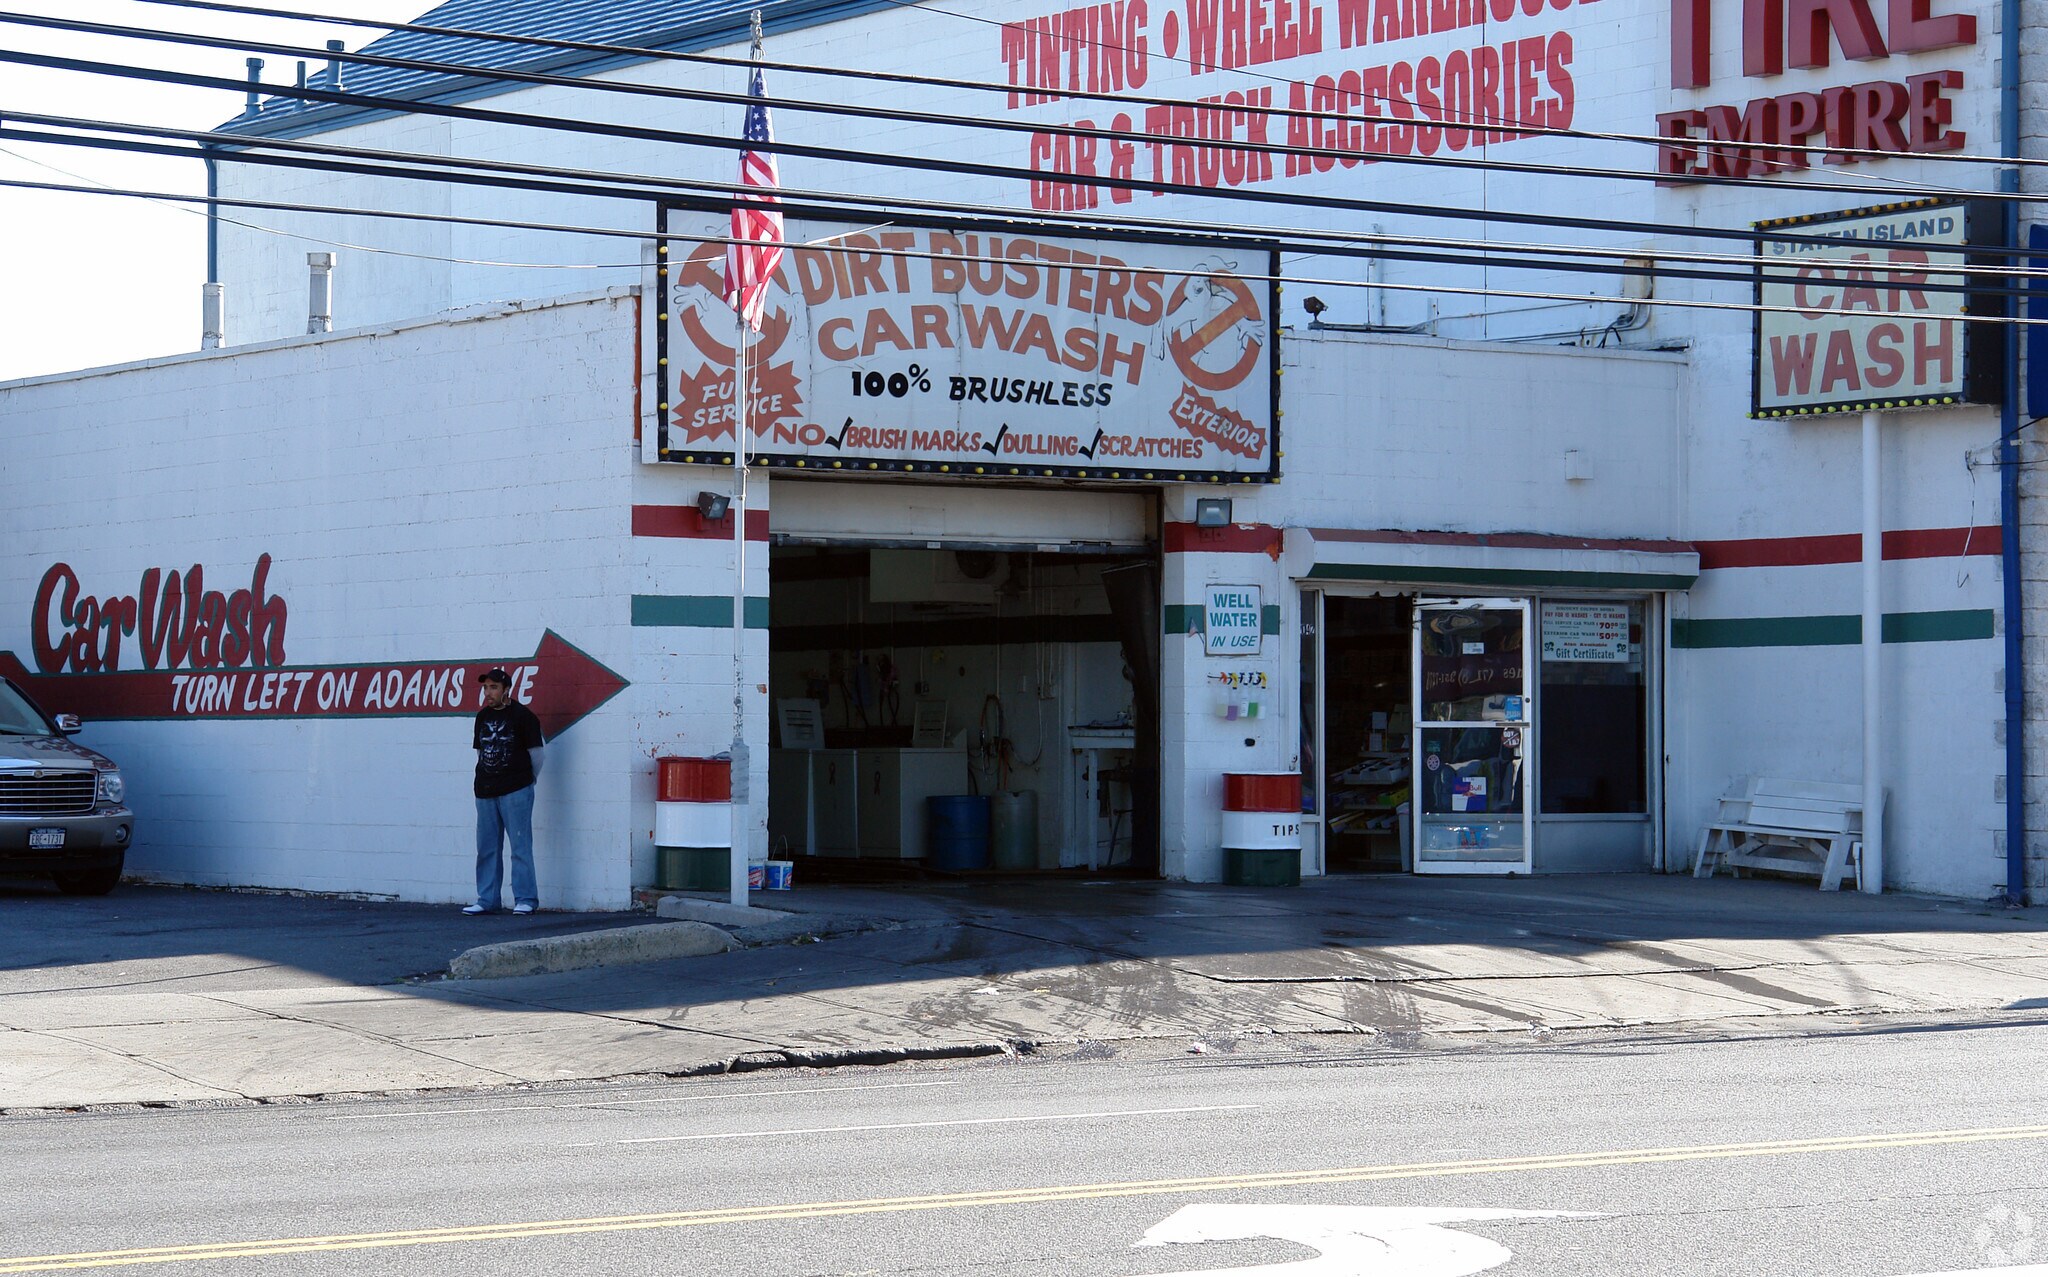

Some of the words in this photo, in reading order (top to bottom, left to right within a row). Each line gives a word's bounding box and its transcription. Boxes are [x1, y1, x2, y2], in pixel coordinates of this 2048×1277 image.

[1001, 0, 1148, 110] TINTING
[1186, 0, 1323, 76] WHEEL
[1030, 119, 1099, 212] CAR
[1110, 112, 1135, 205] &
[1145, 86, 1273, 197] TRUCK
[1286, 30, 1574, 179] ACCESSORIES
[1655, 70, 1967, 188] EMPIRE
[1867, 216, 1955, 241] ISLAND
[793, 232, 916, 306] DIRT
[929, 231, 1165, 327] BUSTERS
[1794, 248, 1930, 321] CAR
[817, 304, 955, 362] CAR
[961, 303, 1146, 386] WASH
[1769, 320, 1954, 397] WASH
[702, 377, 763, 404] FUL
[851, 363, 932, 398] 100%
[949, 376, 1113, 408] BRUSHLESS
[773, 422, 826, 446] NO
[846, 425, 907, 450] BRUSH
[911, 428, 982, 453] MARKS
[1003, 432, 1079, 456] DULLING
[1098, 433, 1204, 459] SCRATCHES
[1175, 393, 1261, 453] EXTERIOR
[31, 562, 138, 674] Car
[138, 552, 288, 670] Wash
[1210, 612, 1258, 628] WATER
[1213, 593, 1253, 609] WELL
[1211, 635, 1227, 648] IN
[1231, 635, 1259, 648] USE
[1556, 648, 1571, 659] Gift
[1573, 648, 1615, 660] Certificates
[171, 674, 237, 714] TURN
[243, 671, 314, 712] LEFT
[317, 671, 358, 711] ON
[364, 668, 466, 709] ADAMS
[478, 665, 540, 706] VE
[1272, 823, 1300, 836] TIPS
